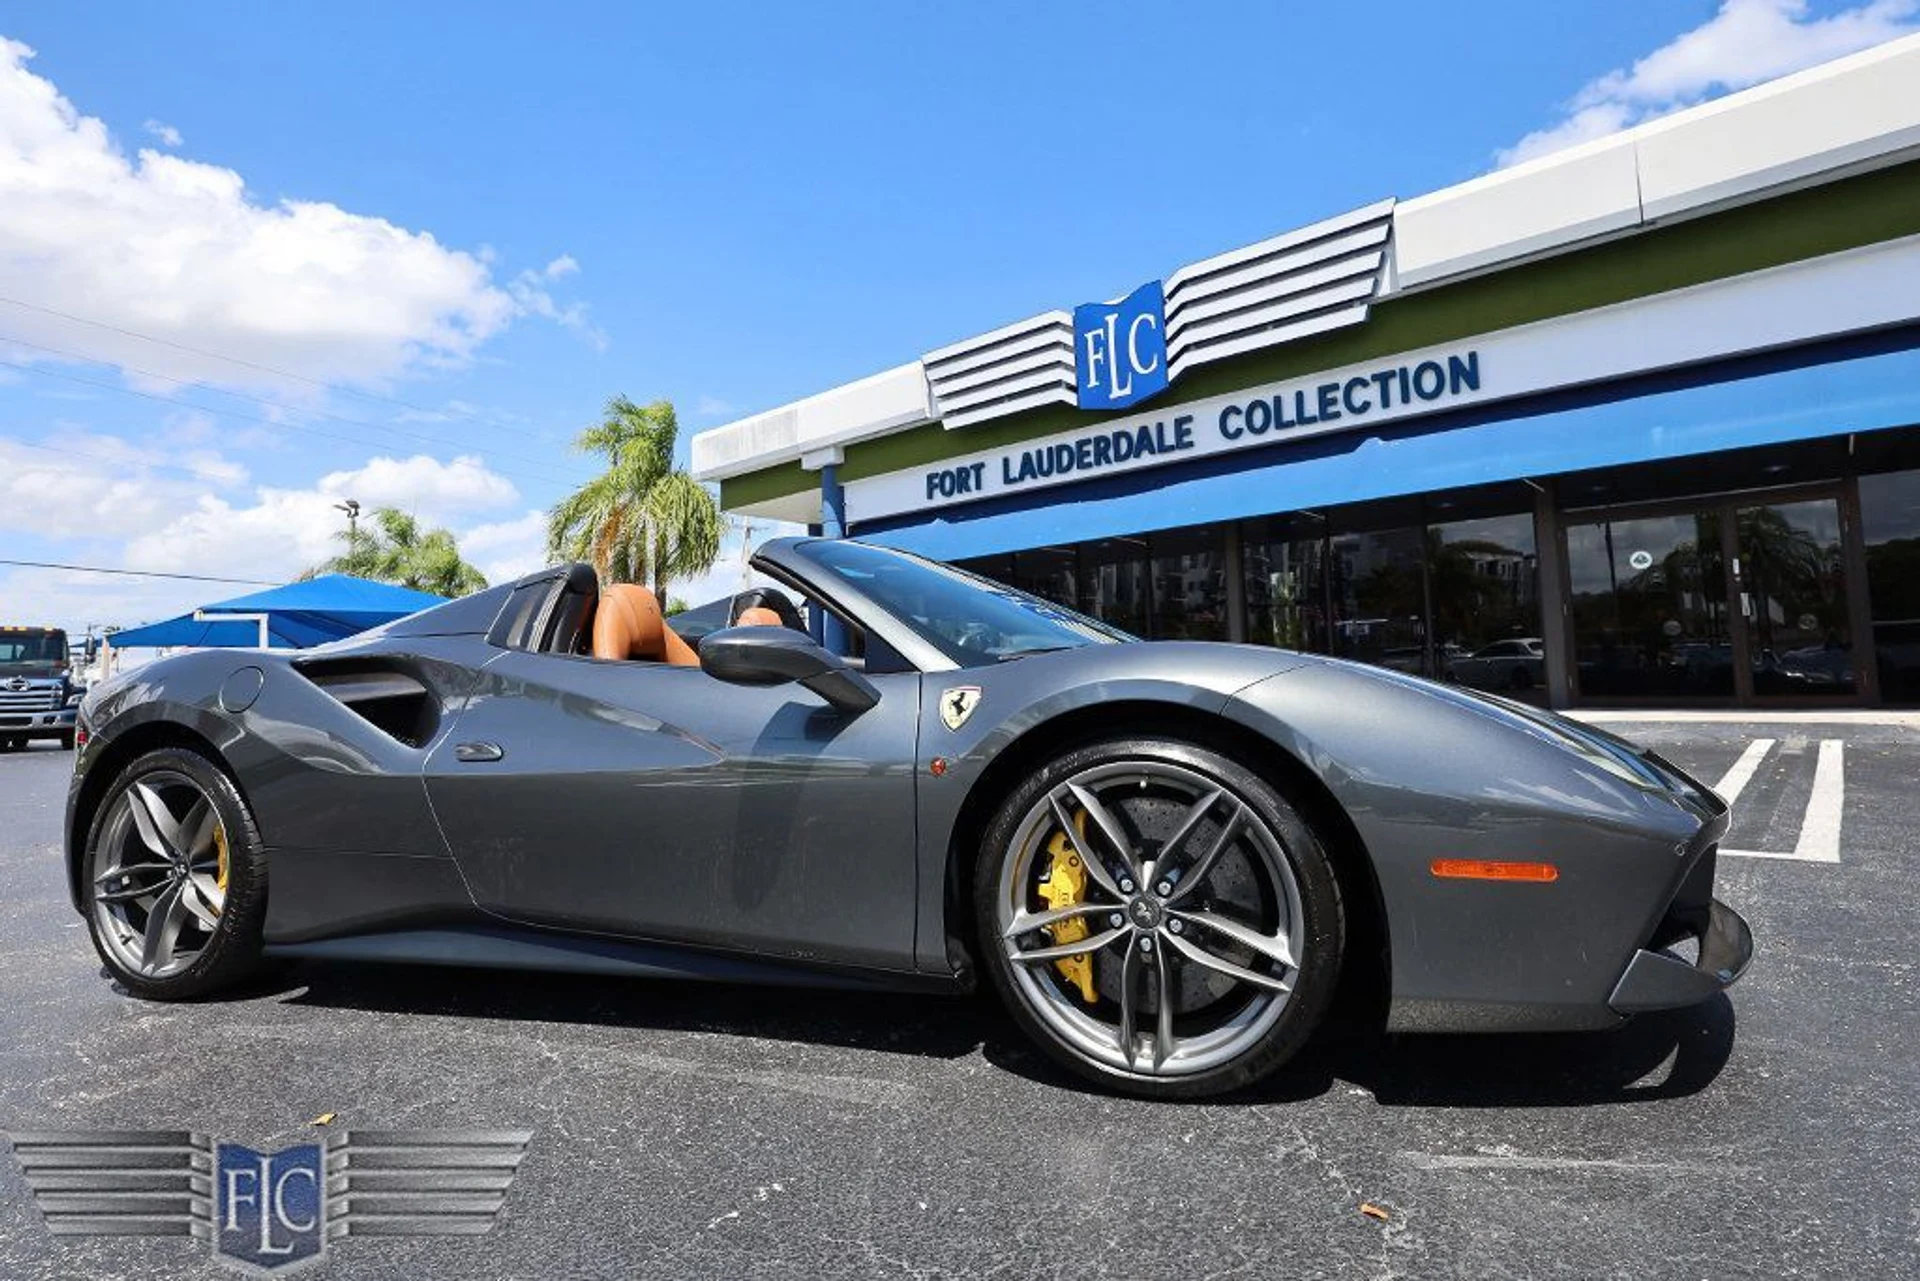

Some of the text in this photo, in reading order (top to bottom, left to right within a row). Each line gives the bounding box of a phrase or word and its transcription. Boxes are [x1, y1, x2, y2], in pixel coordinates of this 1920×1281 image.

[1083, 313, 1159, 400] FLC
[926, 352, 1481, 499] FORT LAUDERDALE COLLECTION
